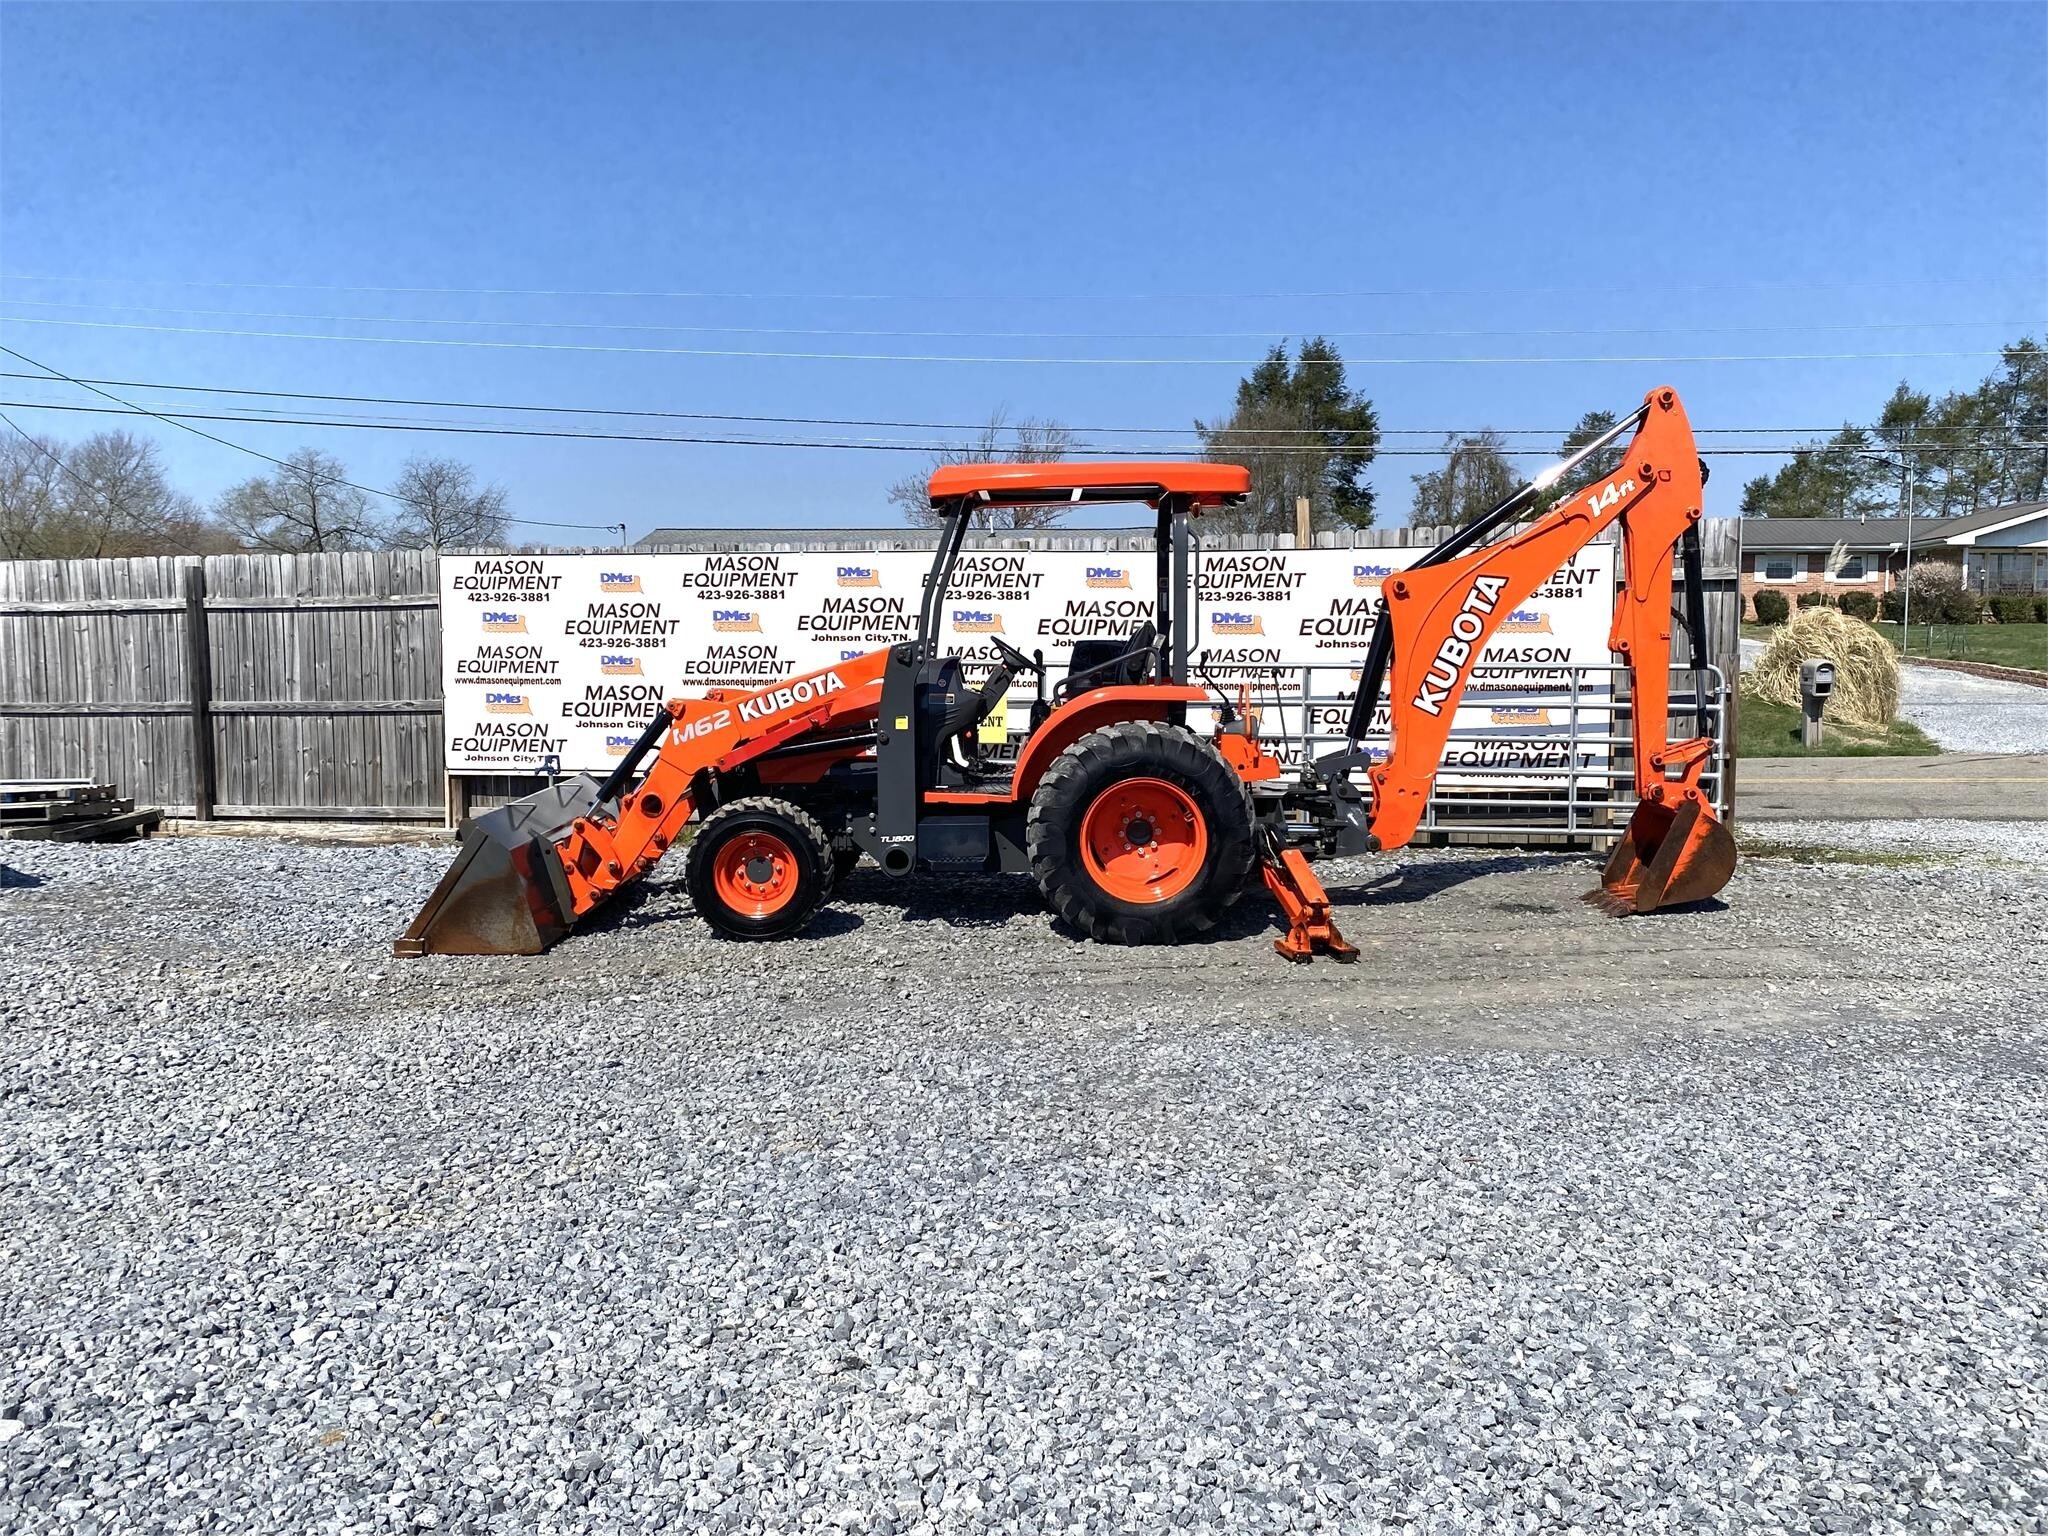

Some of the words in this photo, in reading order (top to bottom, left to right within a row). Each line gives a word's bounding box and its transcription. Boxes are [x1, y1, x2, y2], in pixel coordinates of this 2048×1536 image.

[475, 561, 543, 574] MASON
[705, 557, 779, 571] MASON
[953, 557, 1024, 571] MASON
[1206, 557, 1286, 571] MASON
[453, 576, 562, 589] EQUIPMENT
[683, 573, 798, 587] EQUIPMENT
[922, 574, 1044, 588] EUIPMENT
[468, 593, 549, 601] 423-926-3881
[698, 590, 784, 599] 423-926-3881
[946, 591, 1030, 600] 23-926-3881
[1199, 591, 1291, 601] 423-926-3881
[588, 603, 660, 618] MASON
[823, 598, 904, 613] MASON
[1065, 601, 1155, 617] MASON
[1330, 598, 1383, 616] MAS
[565, 620, 680, 635] EQUIPMENT
[798, 615, 920, 631] EQUIPMENT
[1037, 619, 1143, 635] EQUIPME
[1299, 618, 1376, 635] EQUIP
[579, 638, 665, 647] 423-926-3881
[1413, 573, 1509, 717] KUBOTA
[477, 646, 542, 659] MASON
[707, 646, 777, 659] MASON
[947, 647, 1020, 660] MASO
[1206, 649, 1280, 663] MASON
[1483, 648, 1571, 662] MASON
[458, 660, 559, 673] EQUIPMENT
[685, 661, 795, 674] EQUIPMENT
[455, 677, 561, 686] www.dmasonequipment.com
[586, 686, 663, 700] MASON
[673, 710, 731, 746] M62
[737, 672, 846, 722] KUBOTA
[475, 723, 548, 737] MASON
[452, 738, 567, 752] EQUIPMENT
[1444, 752, 1596, 769] EQUIPMENT
